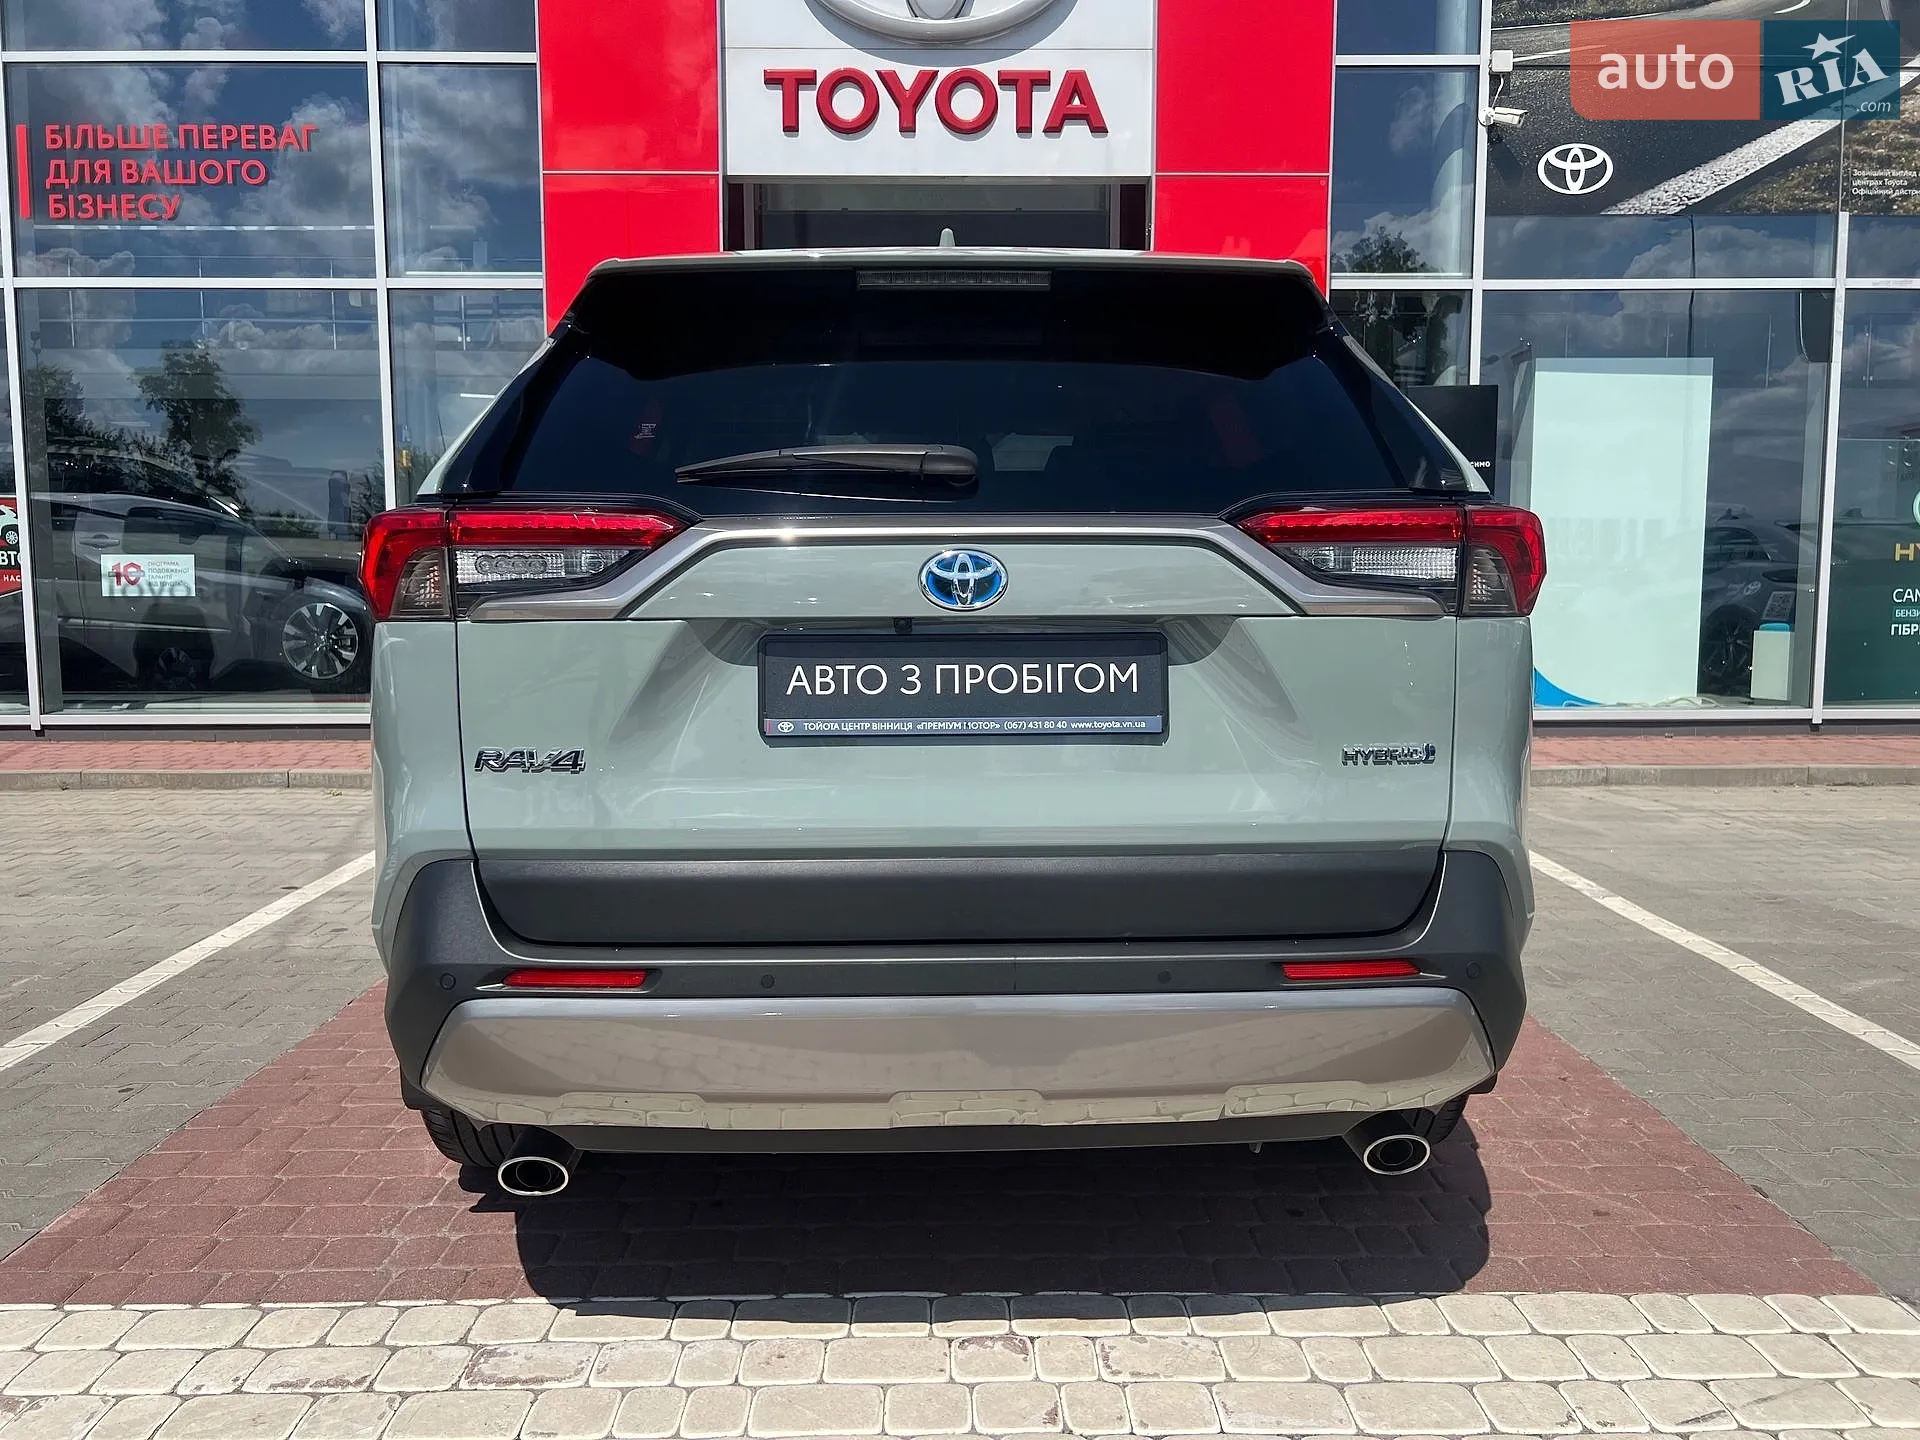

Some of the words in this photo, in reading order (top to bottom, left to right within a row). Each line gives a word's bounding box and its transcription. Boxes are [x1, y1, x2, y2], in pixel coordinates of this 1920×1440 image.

[763, 67, 1109, 135] TOYOTA
[45, 124, 169, 150] БІЛЬШЕ
[178, 124, 318, 150] ПЕРЕВАГ
[46, 159, 112, 189] ДЛЯ
[121, 159, 267, 185] ВАШОГО
[1884, 178, 1908, 187] Toyota
[49, 194, 181, 220] БІЗНЕСУ
[785, 664, 888, 695] АВТО
[899, 664, 922, 695] З
[935, 662, 1138, 695] ПРОБІГОМ
[803, 721, 840, 731] ТОЙОТА
[841, 722, 871, 732] ЦЕНТР
[871, 721, 913, 732] ВІННИЦЯ
[916, 721, 961, 731] «ПРЕМІУМ
[1003, 720, 1027, 731] (067)
[1027, 720, 1042, 730] 431
[1043, 720, 1055, 730] 80
[1056, 720, 1068, 730] 40
[1070, 719, 1146, 731] www.toyota.vn.ua
[474, 748, 586, 774] RAV4
[1342, 745, 1422, 765] HYBRID
